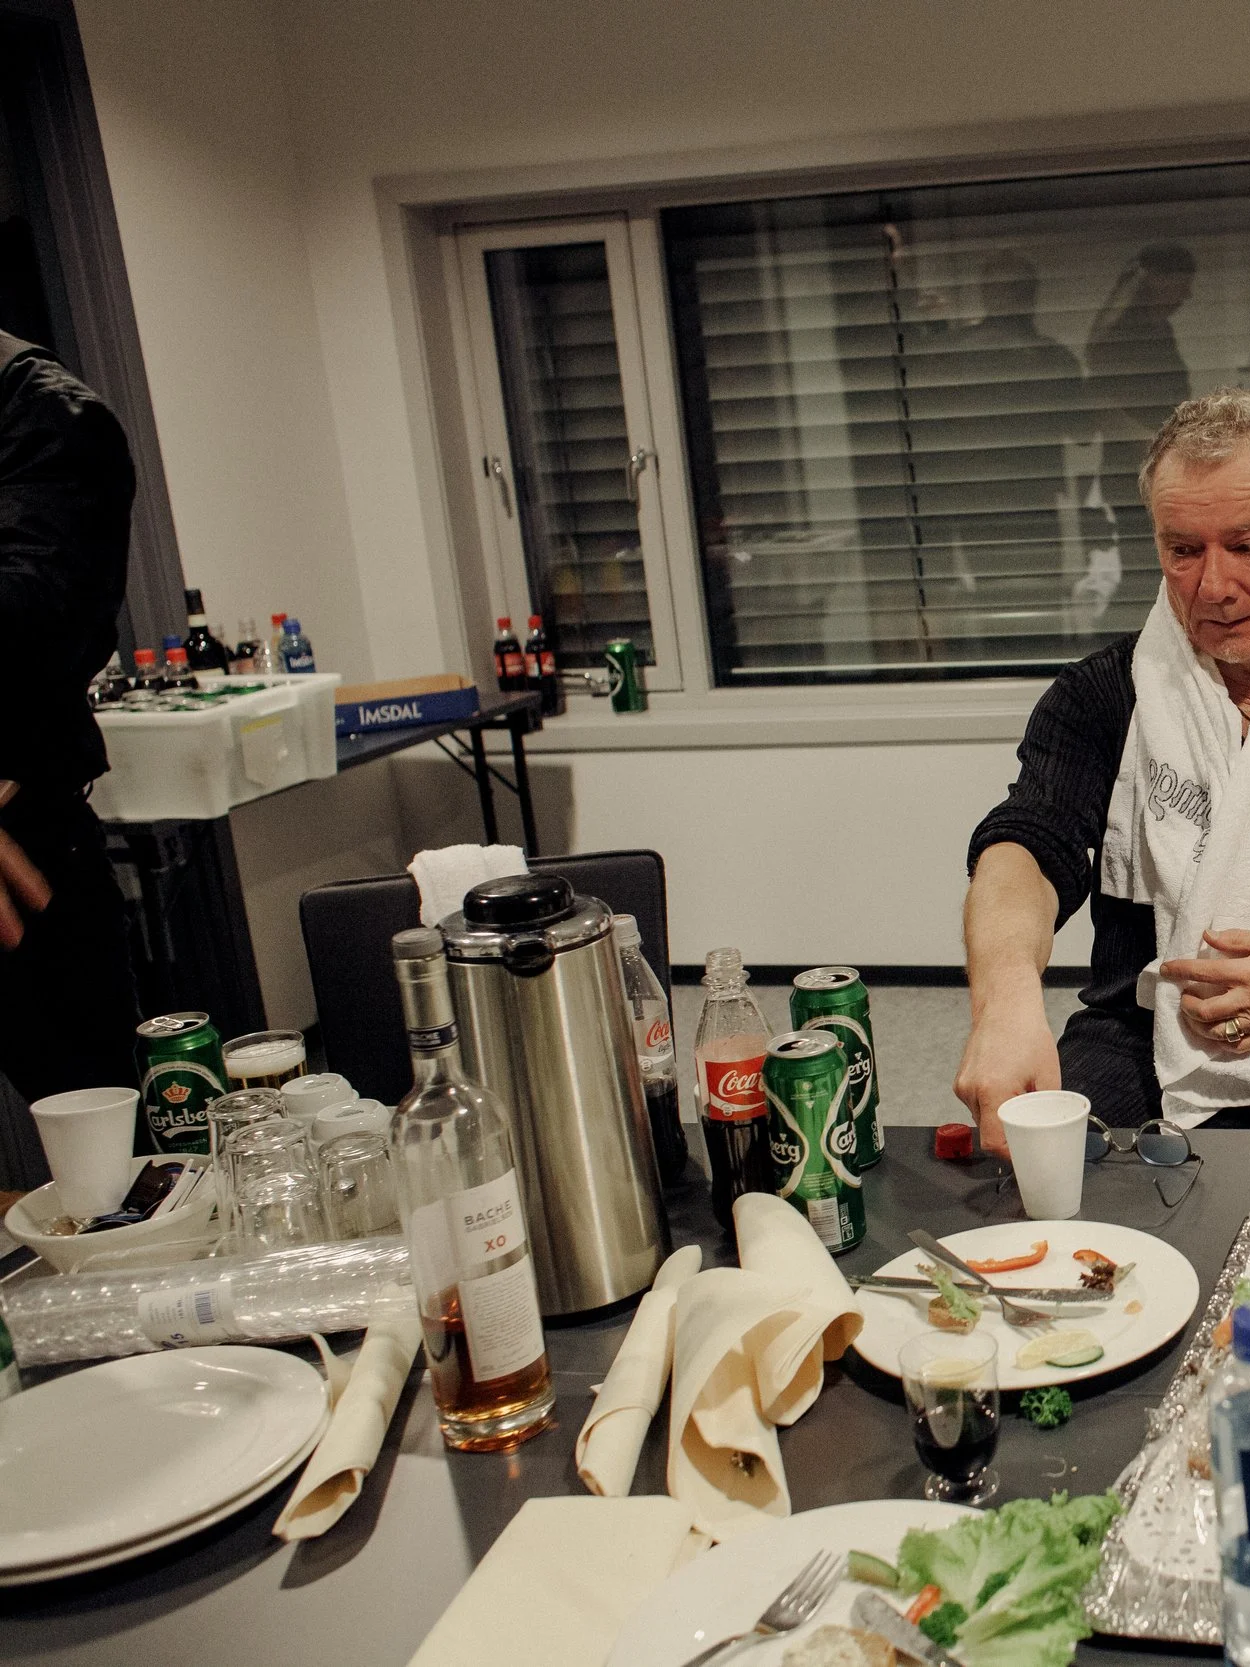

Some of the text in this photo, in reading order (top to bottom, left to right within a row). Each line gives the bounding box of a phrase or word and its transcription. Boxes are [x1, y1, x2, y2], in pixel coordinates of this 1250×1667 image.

[358, 701, 422, 726] IMSDAL
[146, 1104, 208, 1132] Carlsbe
[464, 1200, 512, 1226] BACHE
[484, 1235, 507, 1253] XO
